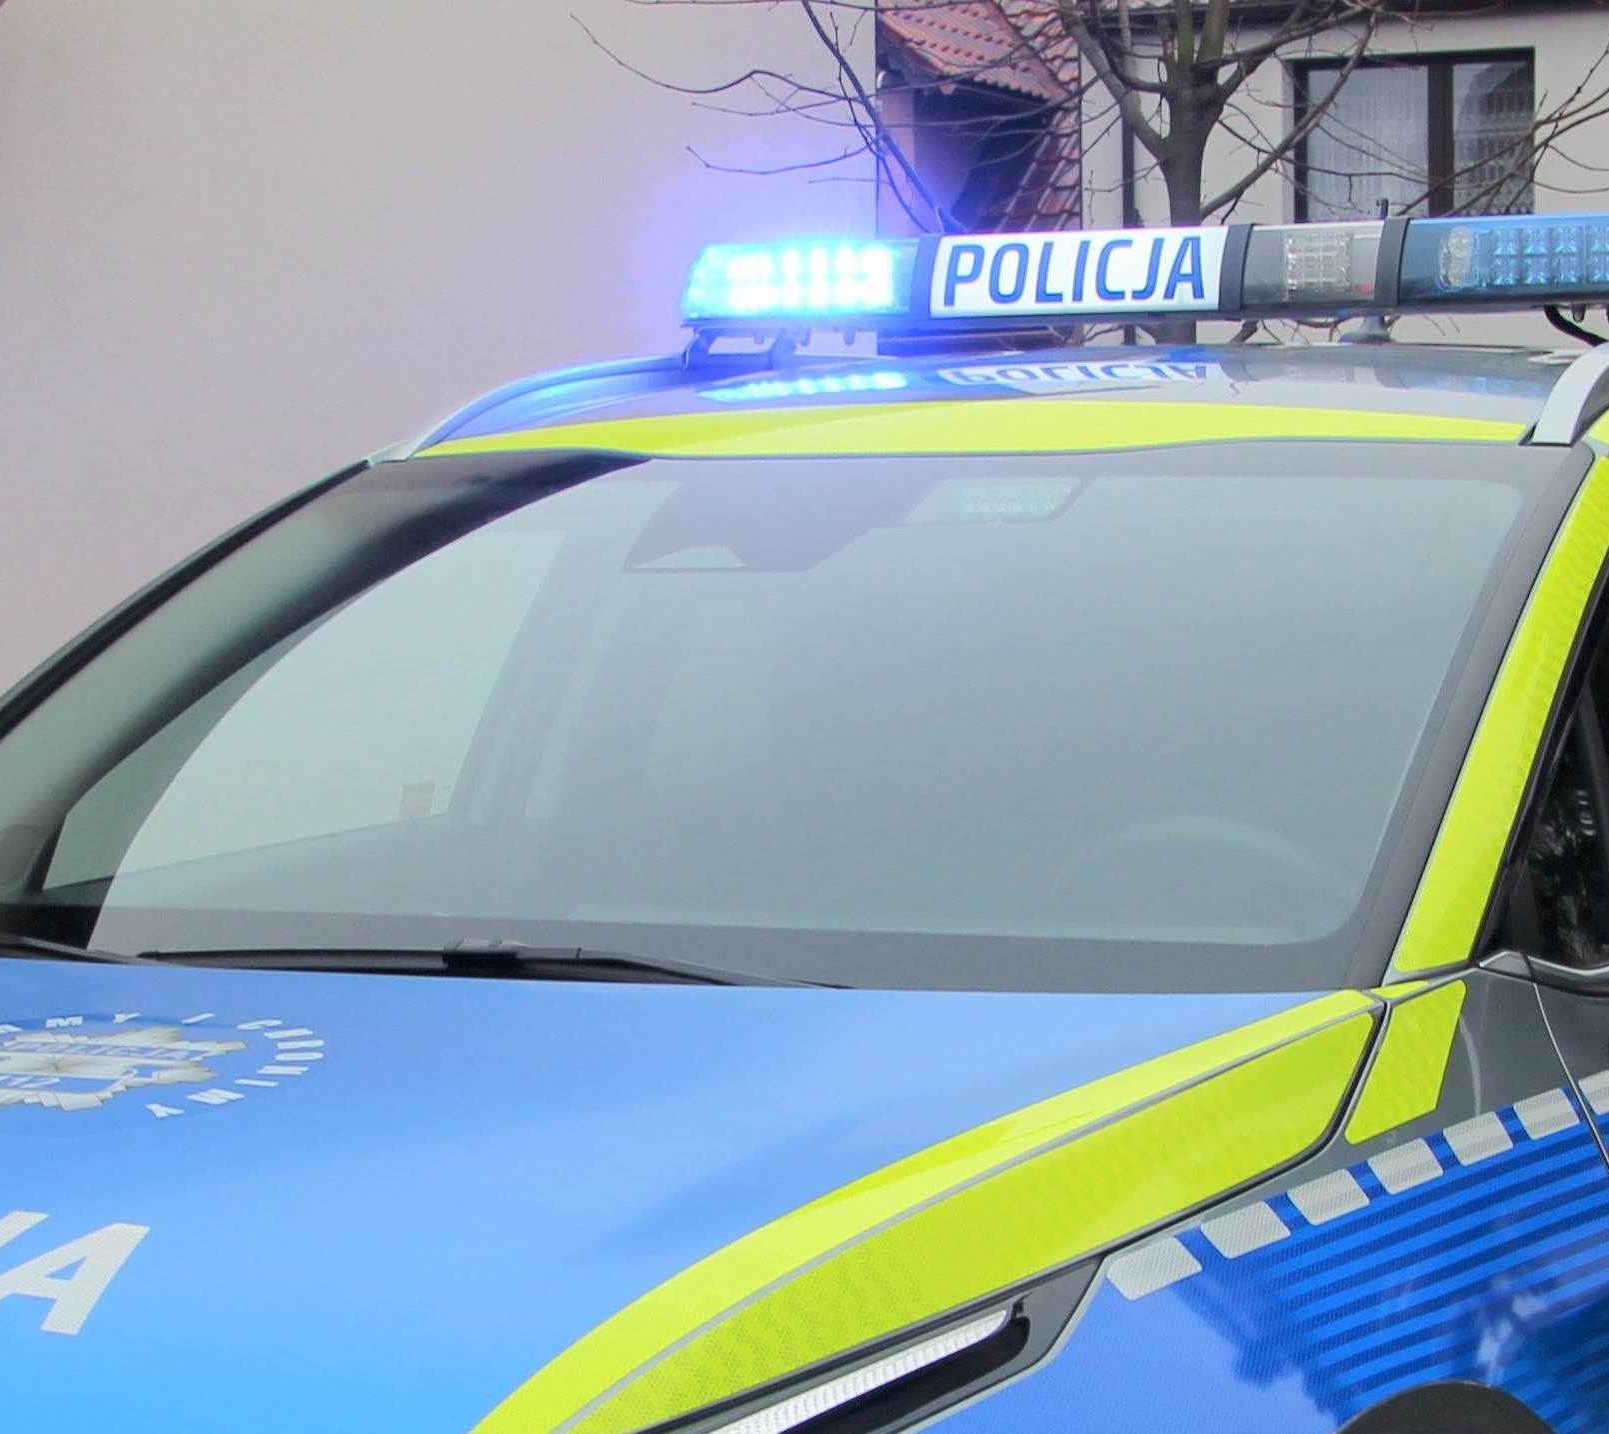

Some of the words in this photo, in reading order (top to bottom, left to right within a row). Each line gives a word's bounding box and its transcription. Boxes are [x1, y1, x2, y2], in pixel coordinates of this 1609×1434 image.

[943, 236, 1205, 307] POLICJA
[181, 1012, 216, 1025] I
[5, 1041, 193, 1060] POLICJA
[145, 1018, 325, 1119] CHRONIMY
